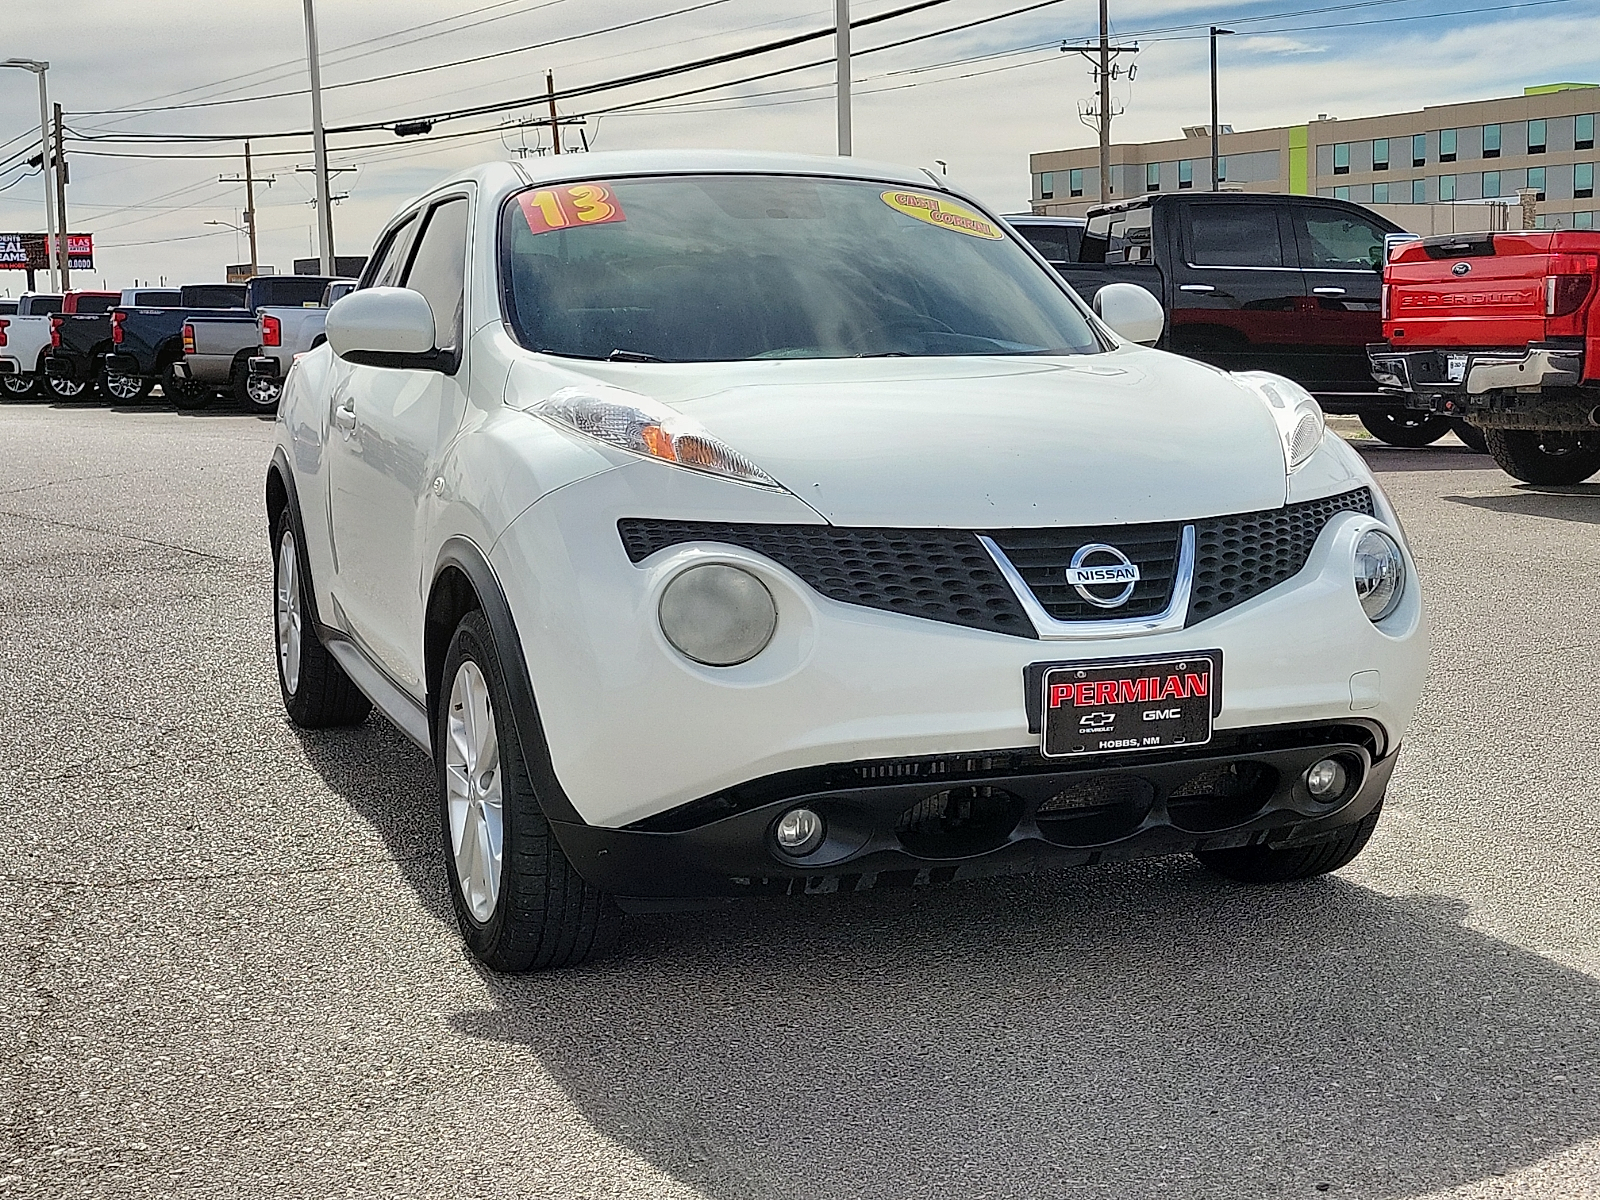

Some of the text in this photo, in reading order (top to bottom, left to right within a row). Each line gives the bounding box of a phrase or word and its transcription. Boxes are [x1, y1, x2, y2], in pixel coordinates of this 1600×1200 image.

[531, 185, 616, 228] 13
[895, 193, 940, 211] CASH
[930, 210, 995, 236] CORRAL
[1401, 291, 1532, 306] SUPER DUTY
[1077, 568, 1135, 581] NISSAN
[1049, 672, 1208, 709] PERMIAN
[1142, 708, 1181, 721] GMC
[1079, 726, 1114, 734] CHEVROLET
[1099, 736, 1160, 750] HOBBS, NM
